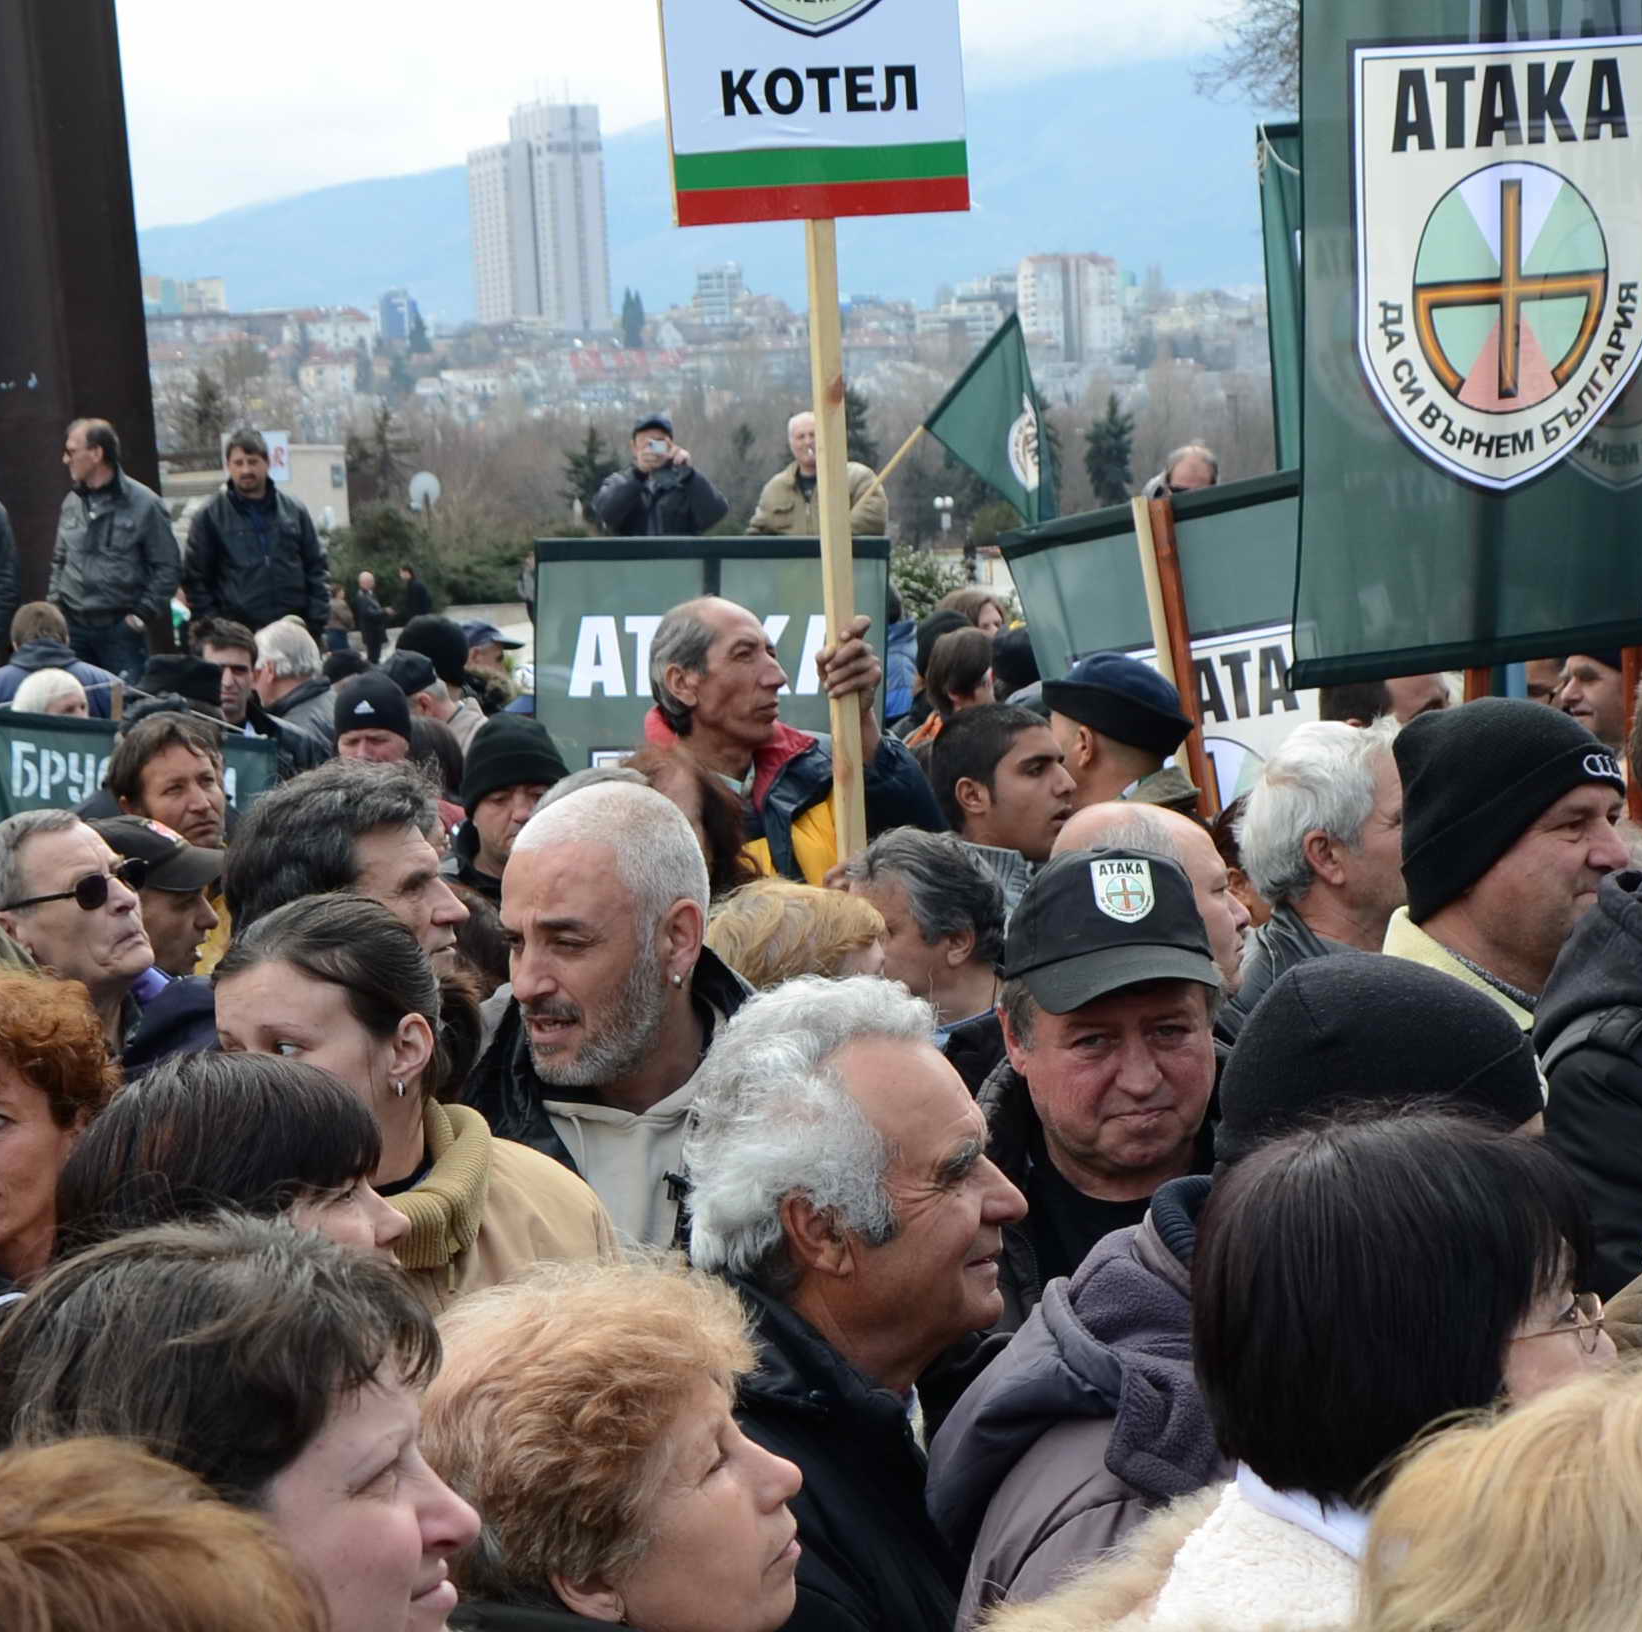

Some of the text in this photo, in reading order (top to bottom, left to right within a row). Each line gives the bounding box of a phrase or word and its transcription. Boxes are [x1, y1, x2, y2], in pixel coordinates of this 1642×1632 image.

[720, 64, 919, 116] КОТЕЛ
[1392, 58, 1629, 153] АТАКА
[1379, 282, 1638, 458] ДА СИ ВЪРНЕМ БЪЛГАРИЯ
[1099, 863, 1145, 876] АТАКА
